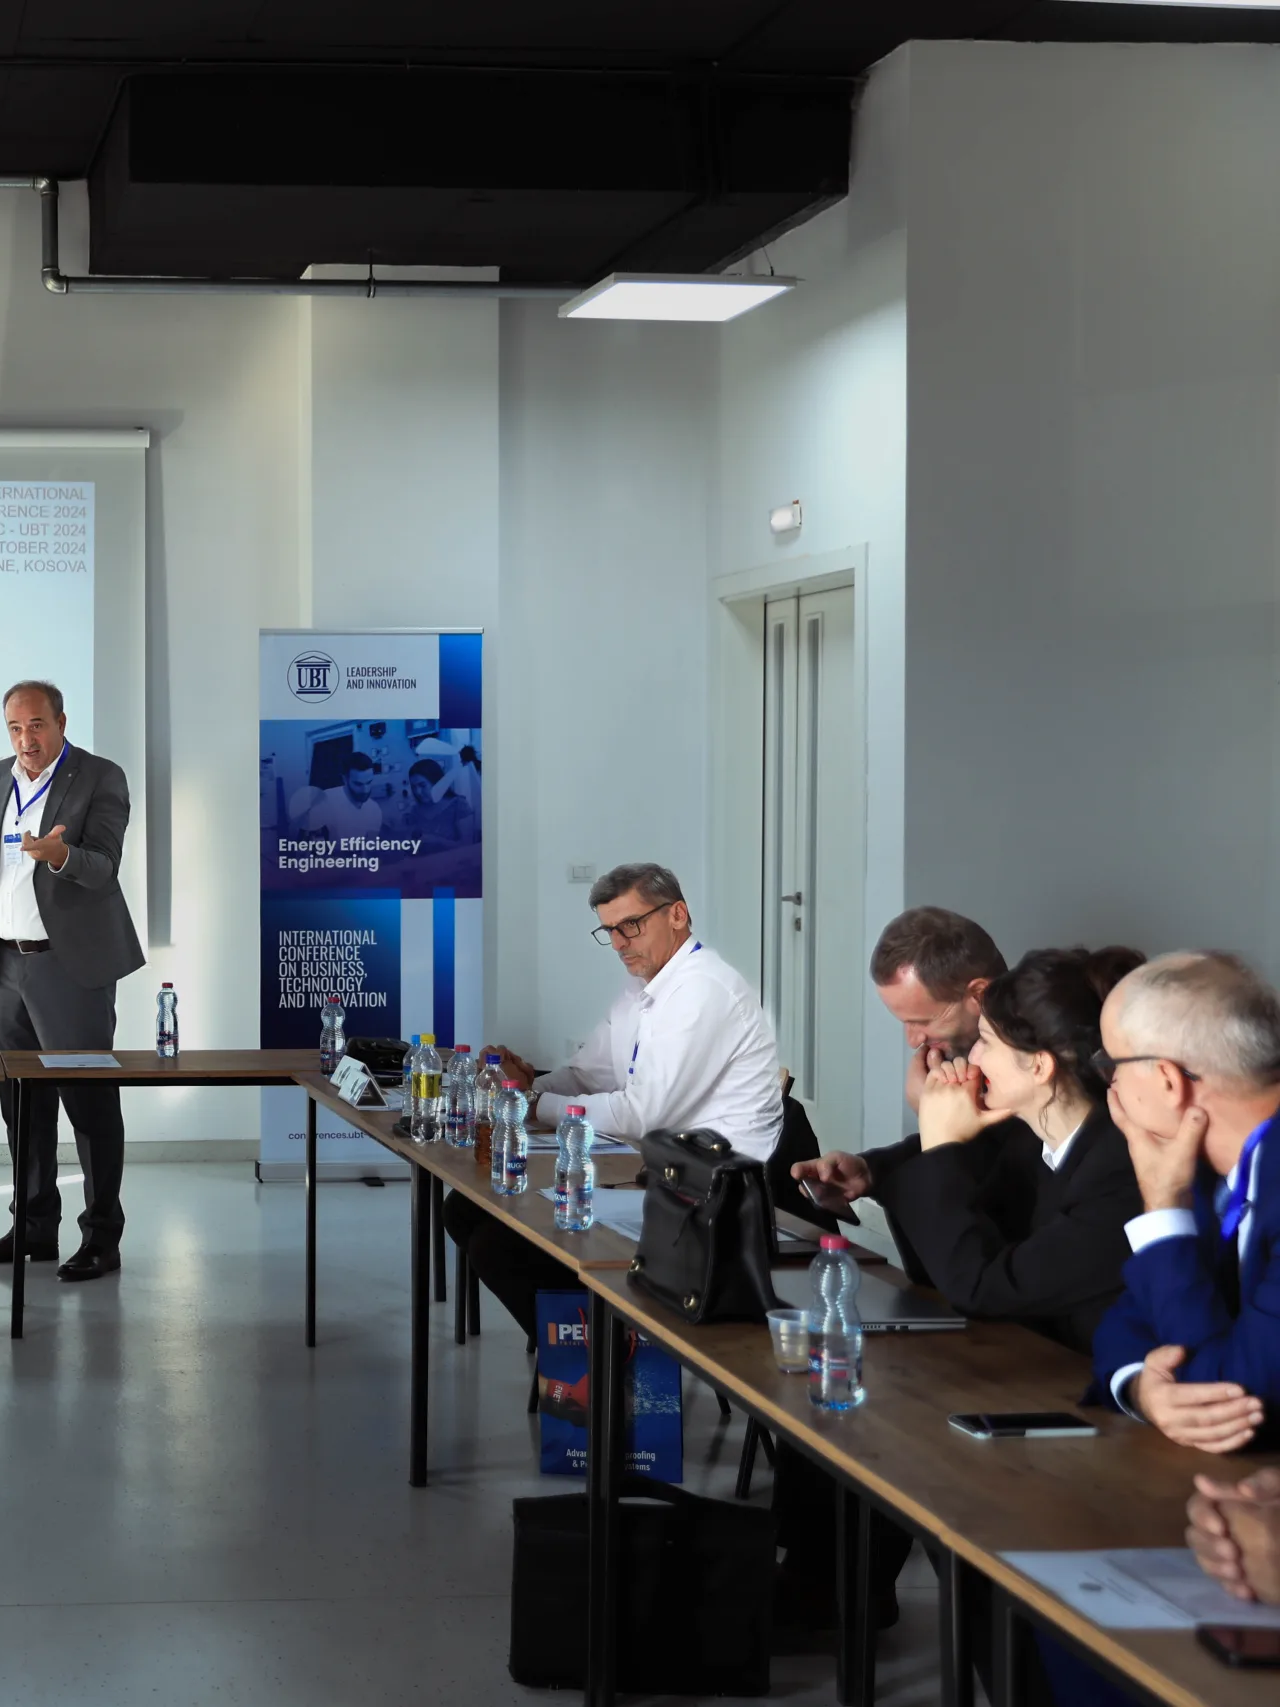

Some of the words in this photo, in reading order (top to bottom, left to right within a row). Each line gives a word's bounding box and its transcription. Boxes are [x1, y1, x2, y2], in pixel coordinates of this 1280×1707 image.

[53, 505, 86, 518] 2024
[20, 523, 49, 536] UBT
[53, 524, 86, 536] 2024
[53, 542, 86, 554] 2024
[24, 560, 87, 573] KOSOVA
[297, 667, 330, 689] UBT
[346, 666, 397, 677] LEADERSHIP
[346, 679, 364, 690] AND
[366, 678, 417, 690] INNOVATION
[278, 838, 337, 855] Energy
[340, 836, 422, 854] Efficiency
[278, 855, 379, 872] Engineering
[279, 930, 377, 945] INTERNATIONAL
[279, 945, 361, 961] CONFERENCE
[279, 961, 297, 977] ON
[301, 961, 368, 978] BUSINESS,
[279, 976, 364, 992] TECHNOLOGY
[279, 993, 305, 1008] AND
